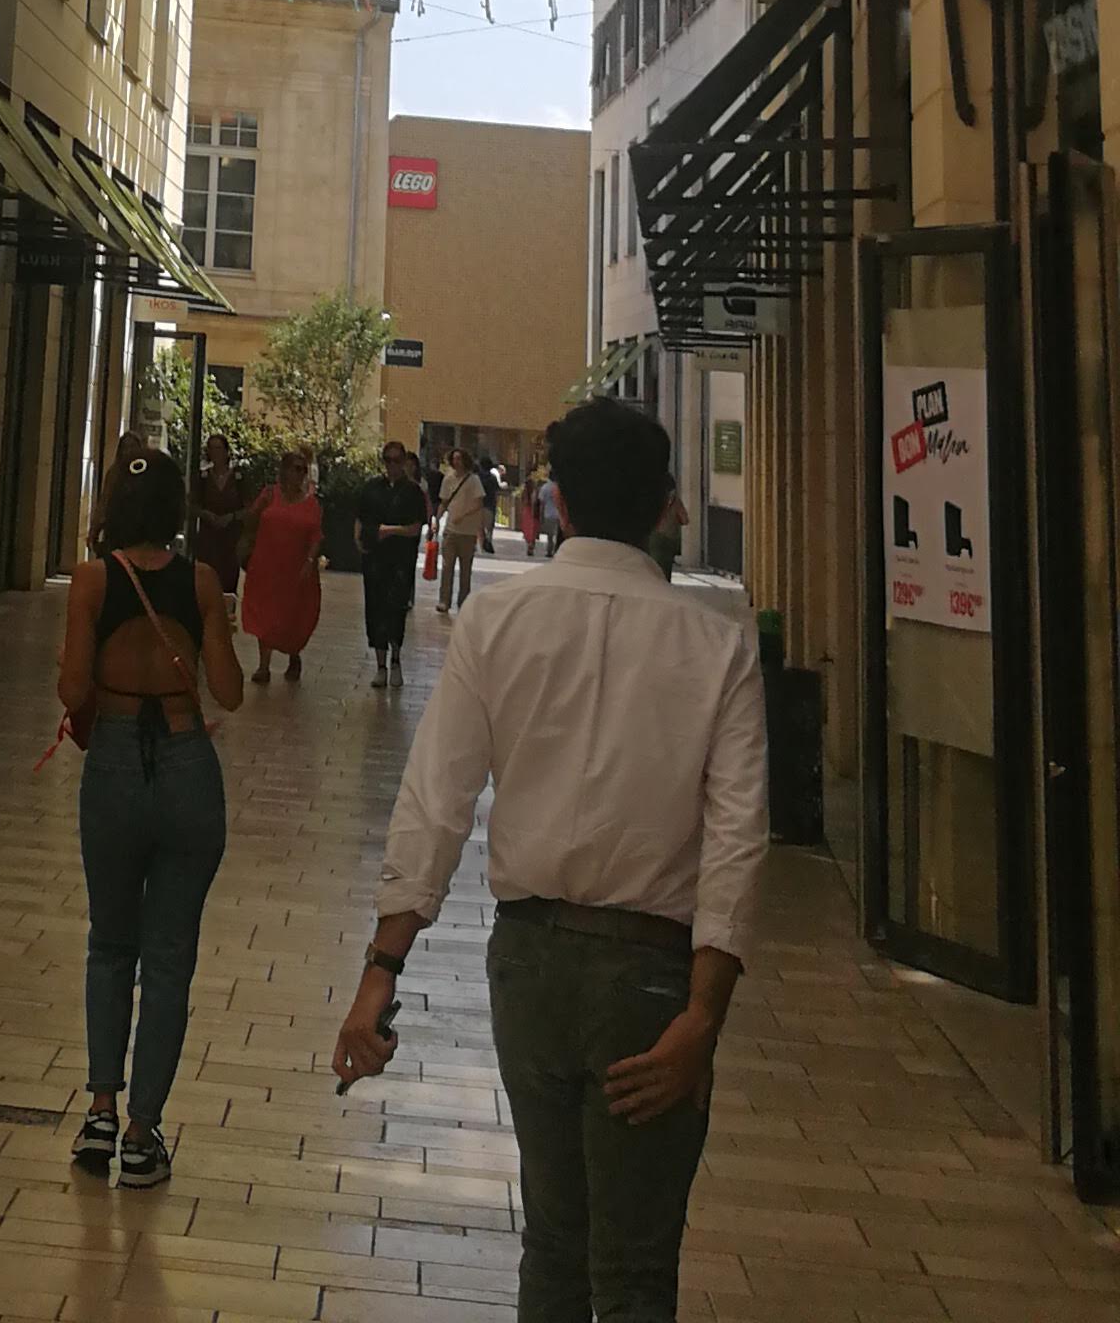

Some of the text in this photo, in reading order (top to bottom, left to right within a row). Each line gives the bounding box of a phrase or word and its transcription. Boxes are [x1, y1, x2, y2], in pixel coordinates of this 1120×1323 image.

[393, 171, 434, 192] LEGO
[916, 388, 945, 419] PLAN
[898, 428, 922, 463] BON
